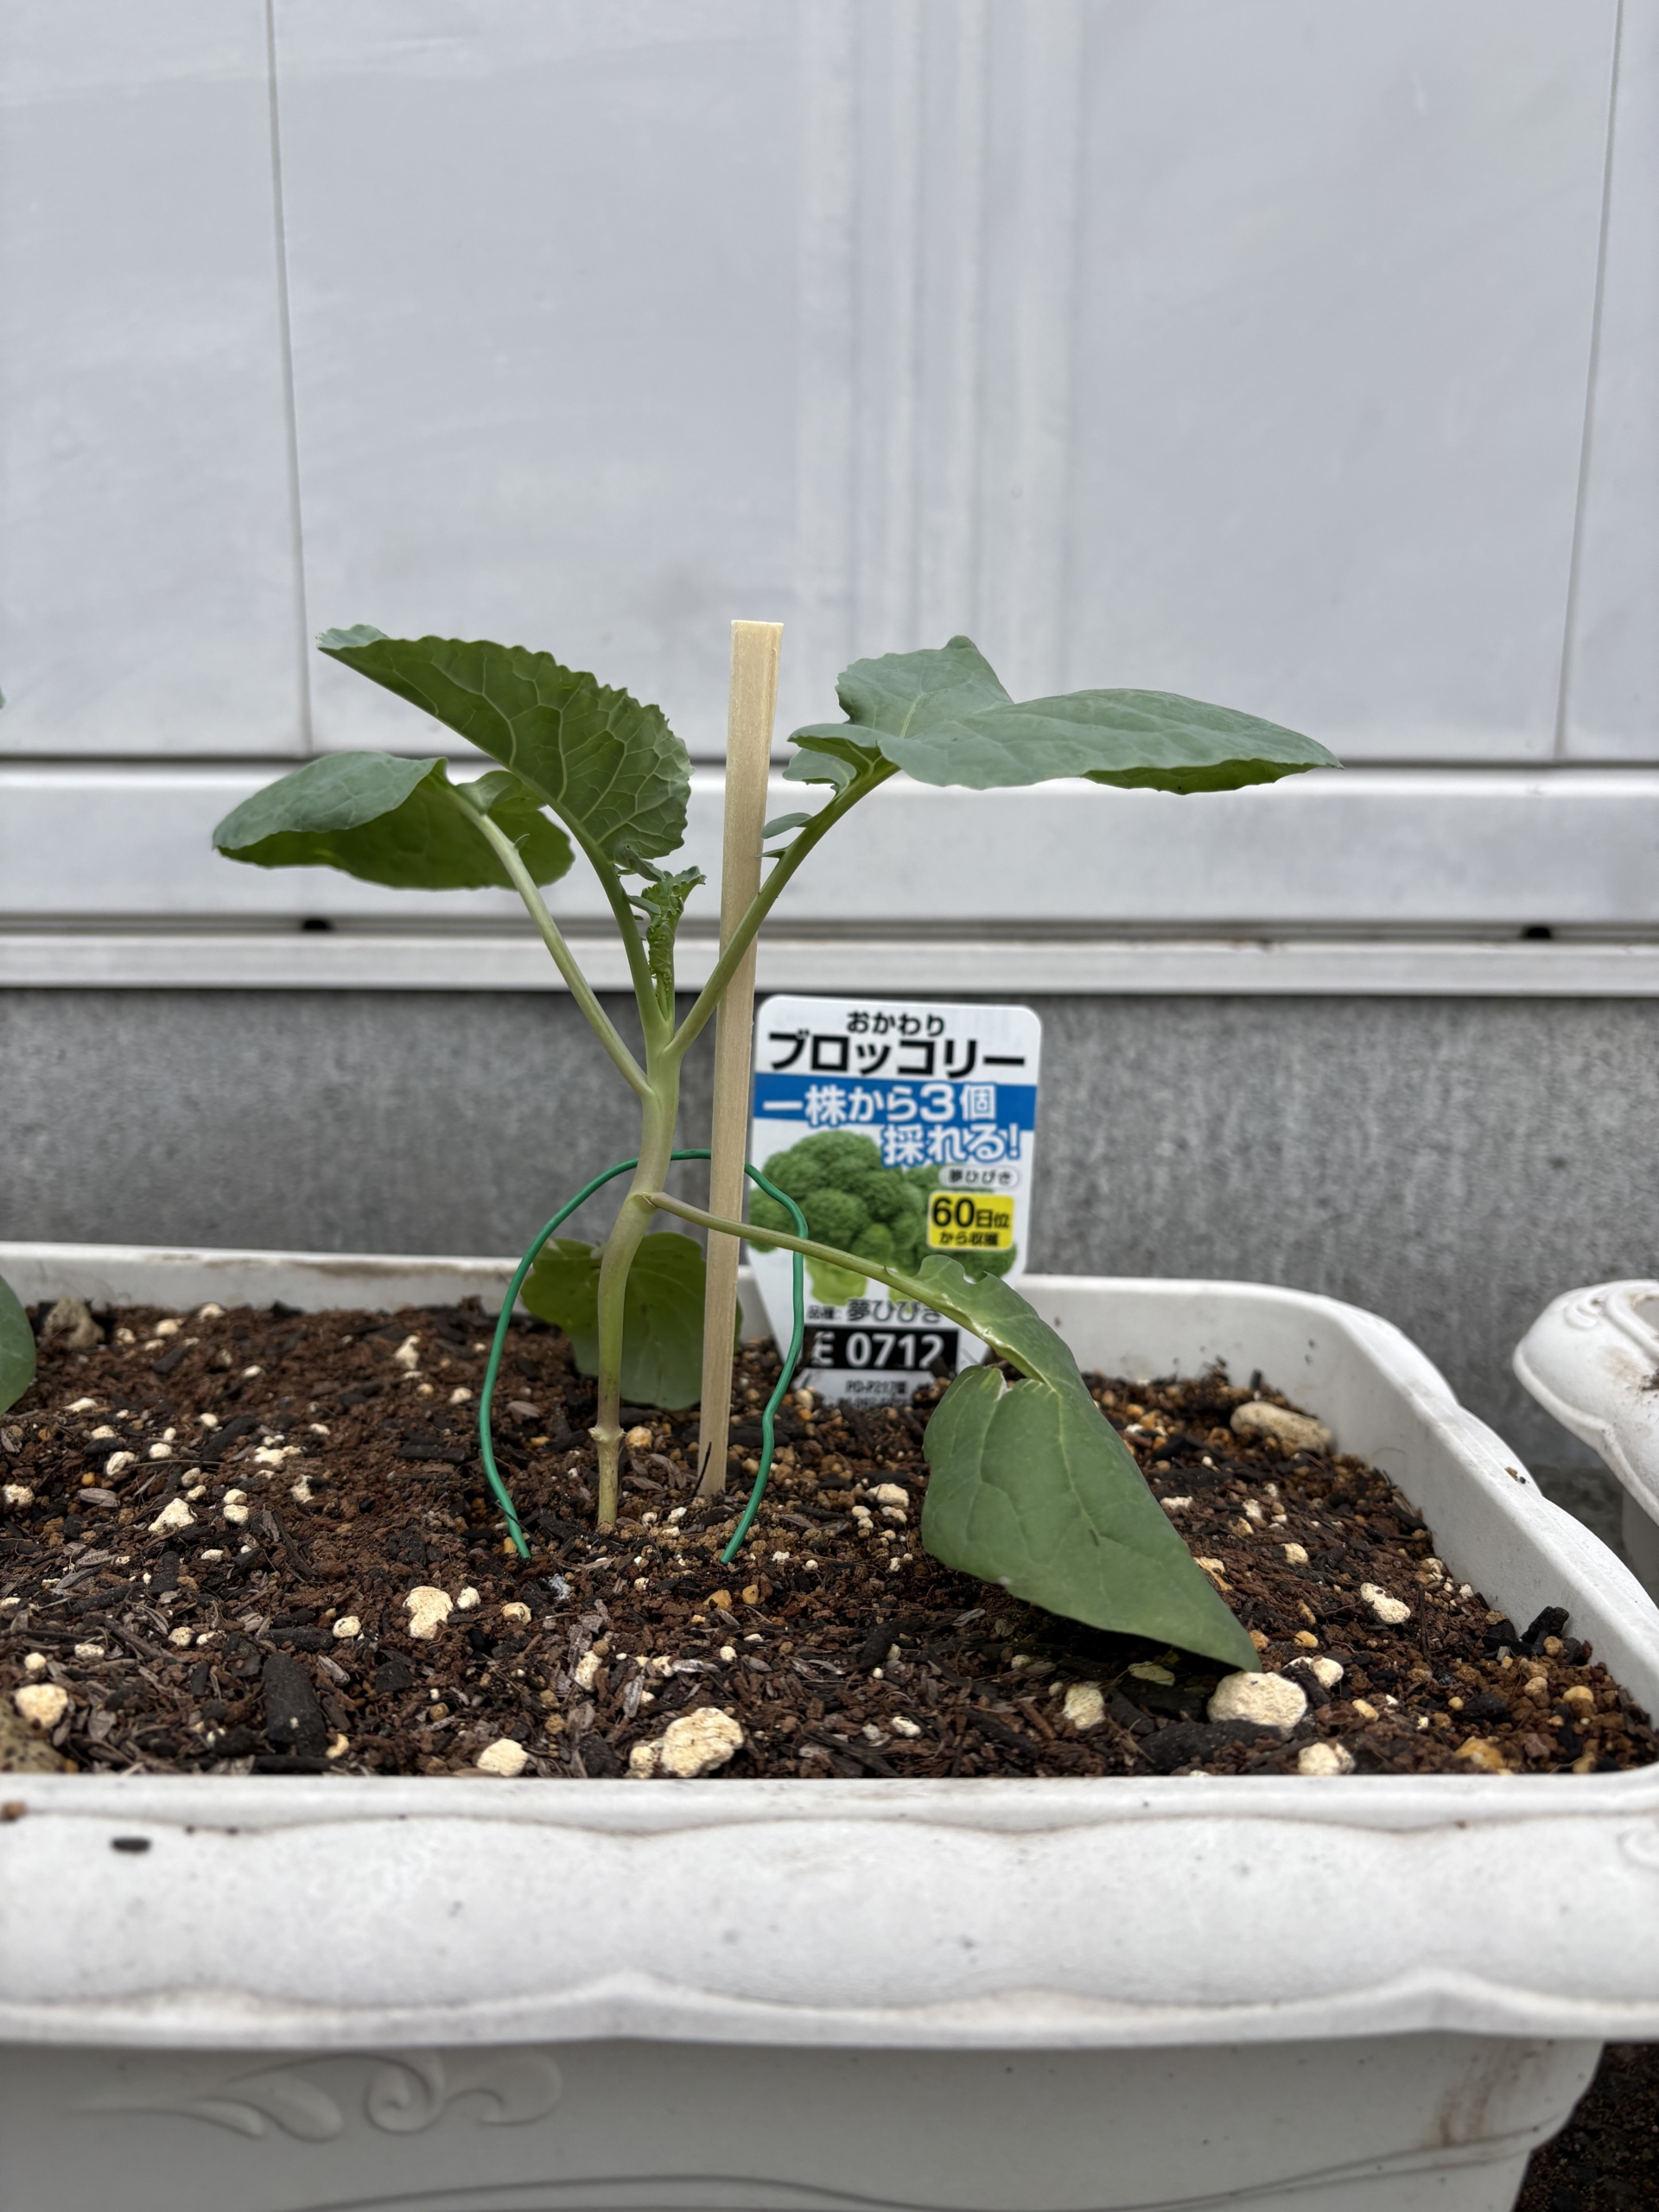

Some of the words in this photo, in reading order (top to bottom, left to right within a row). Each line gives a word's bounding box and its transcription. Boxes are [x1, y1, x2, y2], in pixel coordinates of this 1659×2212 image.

[847, 1011, 945, 1037] おかわり
[768, 1029, 1026, 1079] ブロッコリー
[763, 1083, 997, 1126] 一株から3個
[882, 1124, 1020, 1166] 採れる!
[948, 1169, 1011, 1185] 夢ひびき
